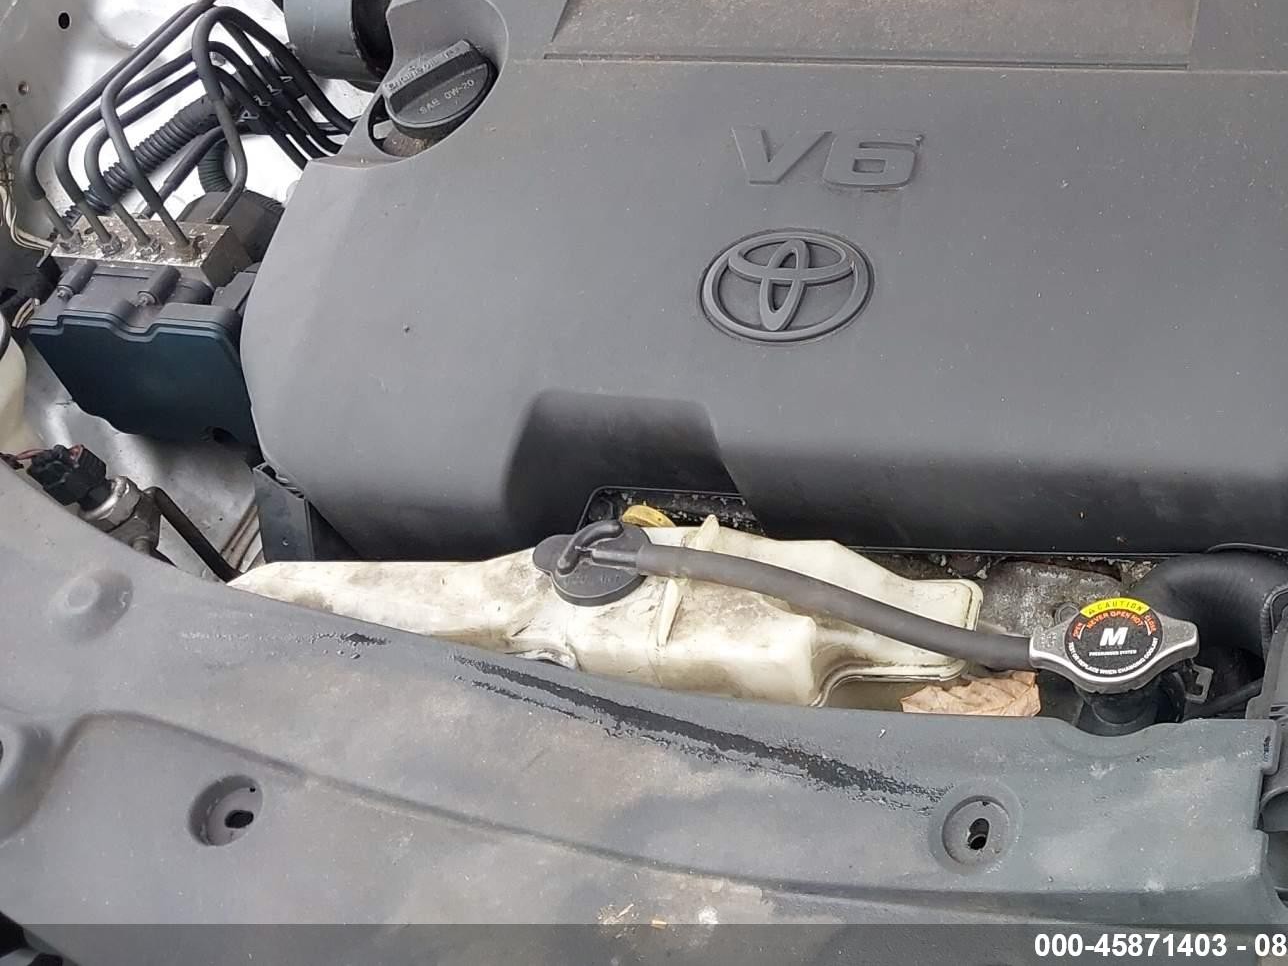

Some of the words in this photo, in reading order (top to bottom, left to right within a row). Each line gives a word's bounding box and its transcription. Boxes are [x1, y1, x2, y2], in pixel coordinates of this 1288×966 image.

[418, 98, 441, 114] SAE
[443, 79, 475, 100] 0W-20
[730, 126, 922, 189] V6
[1098, 601, 1142, 611] CAUTION
[1087, 612, 1109, 628] NEVER
[1110, 610, 1130, 619] OPEN
[1131, 614, 1144, 626] HOT
[1099, 627, 1129, 646] M
